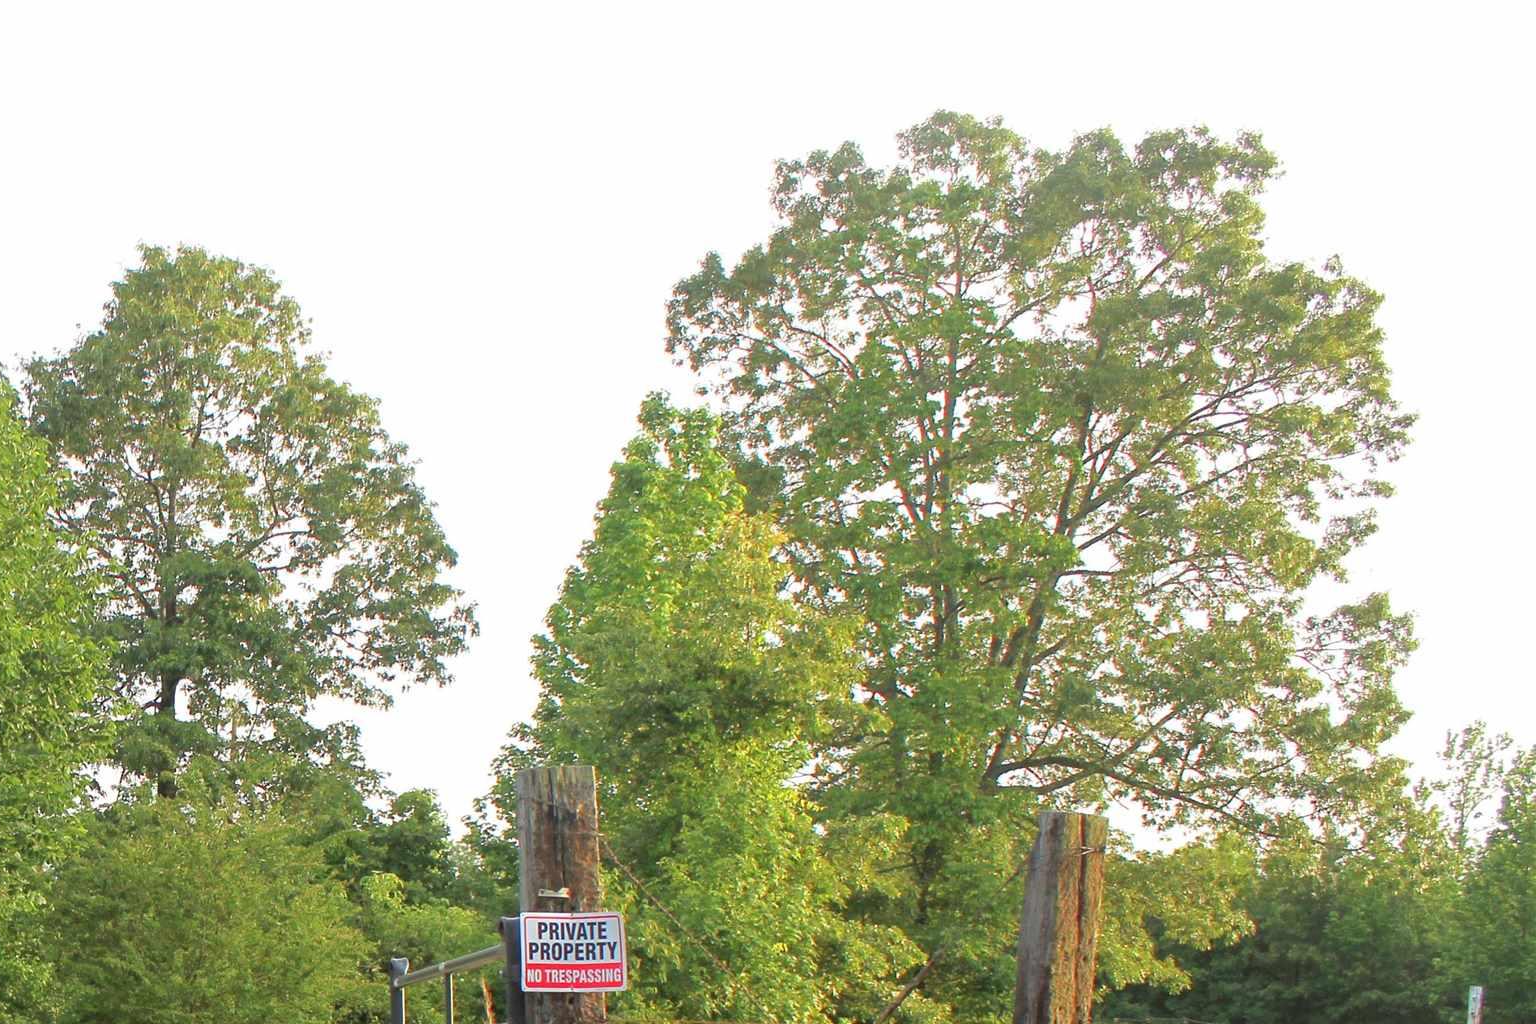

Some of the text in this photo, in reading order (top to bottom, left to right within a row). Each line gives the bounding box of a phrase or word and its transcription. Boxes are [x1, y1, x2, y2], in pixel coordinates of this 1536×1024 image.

[537, 922, 607, 940] PRIVATE
[528, 942, 617, 961] PROPERTY
[527, 968, 621, 984] NO TRESPASSING
